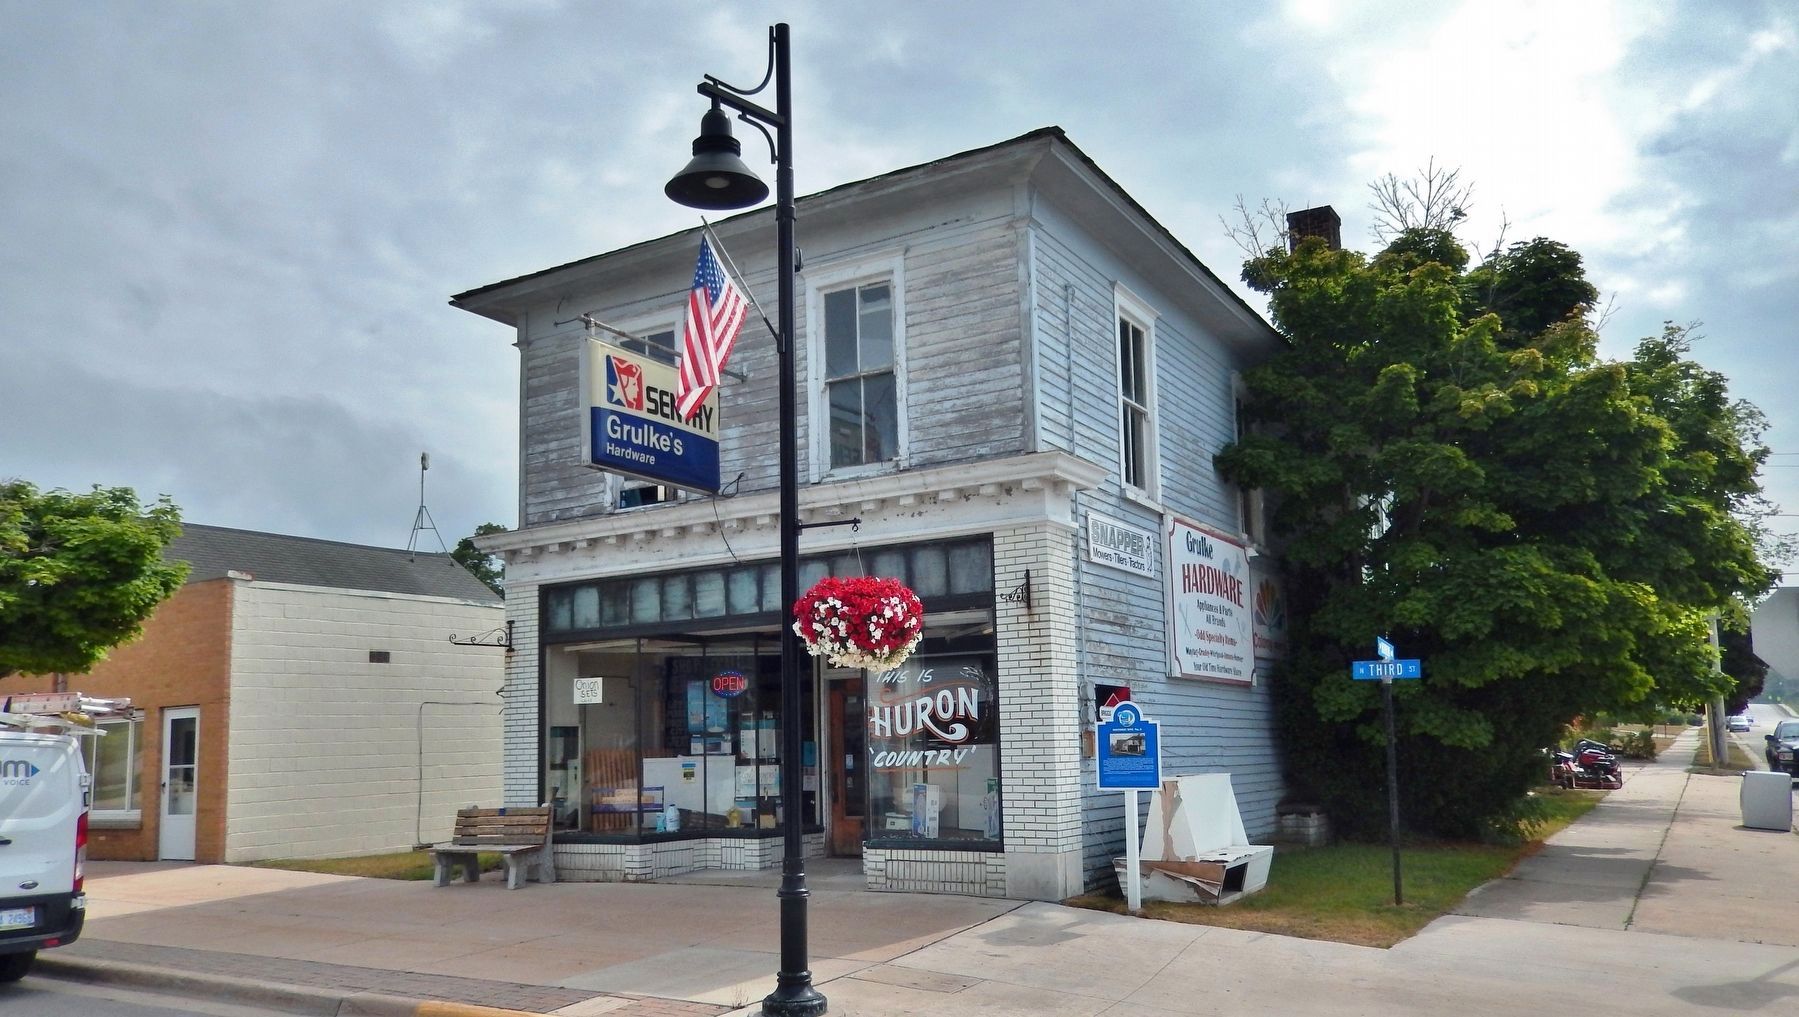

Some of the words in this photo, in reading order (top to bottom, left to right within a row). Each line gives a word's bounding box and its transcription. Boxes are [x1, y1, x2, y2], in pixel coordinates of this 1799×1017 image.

[607, 415, 684, 456] Grulke's
[606, 442, 656, 465] Hardware
[1091, 520, 1145, 557] SNAPPER
[1186, 530, 1213, 560] Grulke
[1182, 563, 1244, 608] HARDWARE
[713, 676, 744, 691] OPEN
[877, 670, 909, 683] THIS
[917, 669, 934, 683] IS
[1369, 663, 1403, 677] THIRD
[869, 687, 979, 740] HURON
